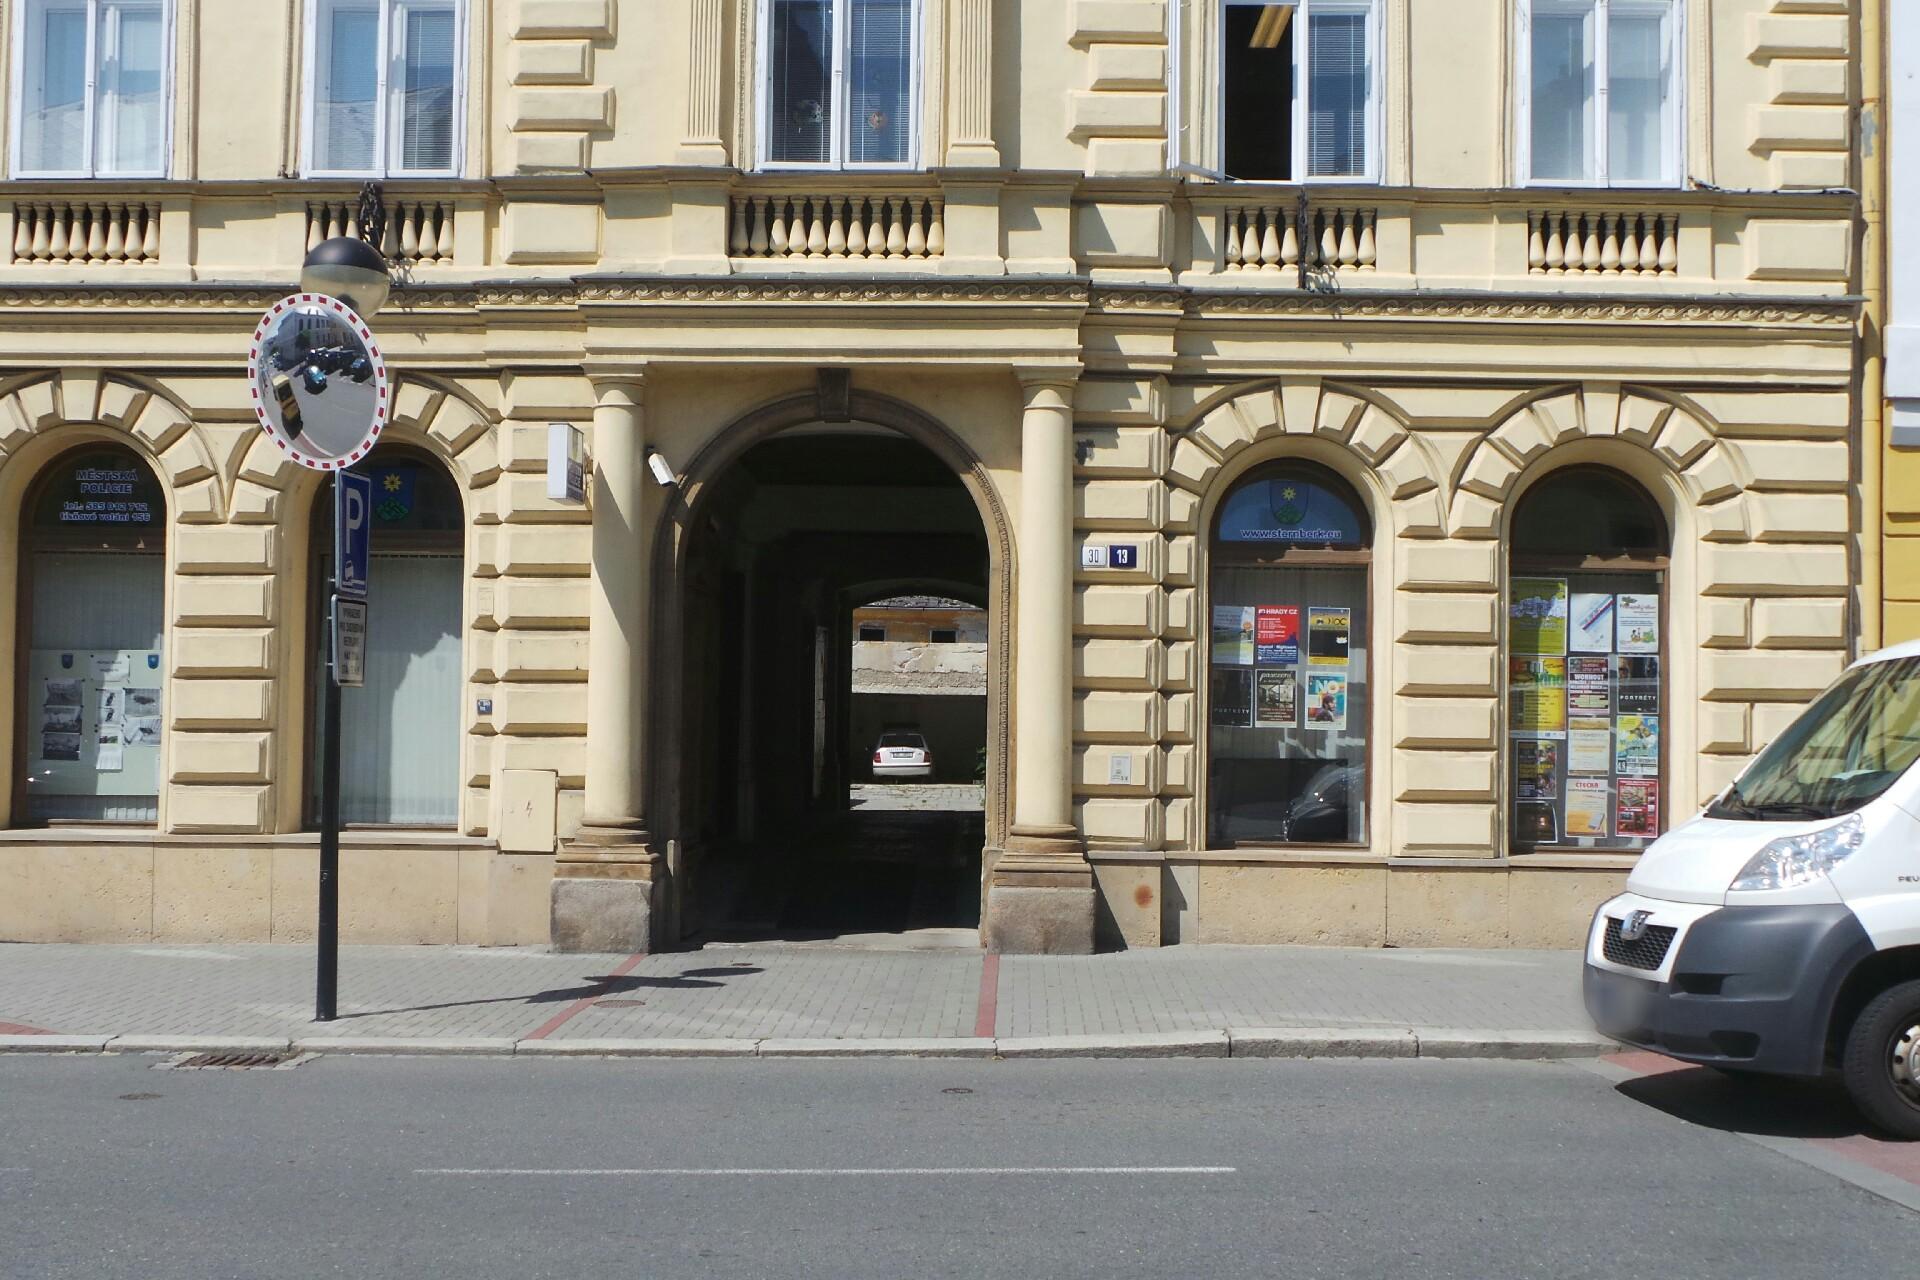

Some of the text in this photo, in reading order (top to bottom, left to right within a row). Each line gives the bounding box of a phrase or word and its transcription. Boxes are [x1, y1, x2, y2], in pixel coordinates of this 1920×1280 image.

[76, 468, 138, 481] MĚSTSKÁ
[80, 482, 133, 494] POLICIE
[346, 488, 364, 554] P
[1240, 528, 1342, 539] www.sternberk.eu
[1088, 549, 1099, 563] 30
[1116, 549, 1128, 564] 13
